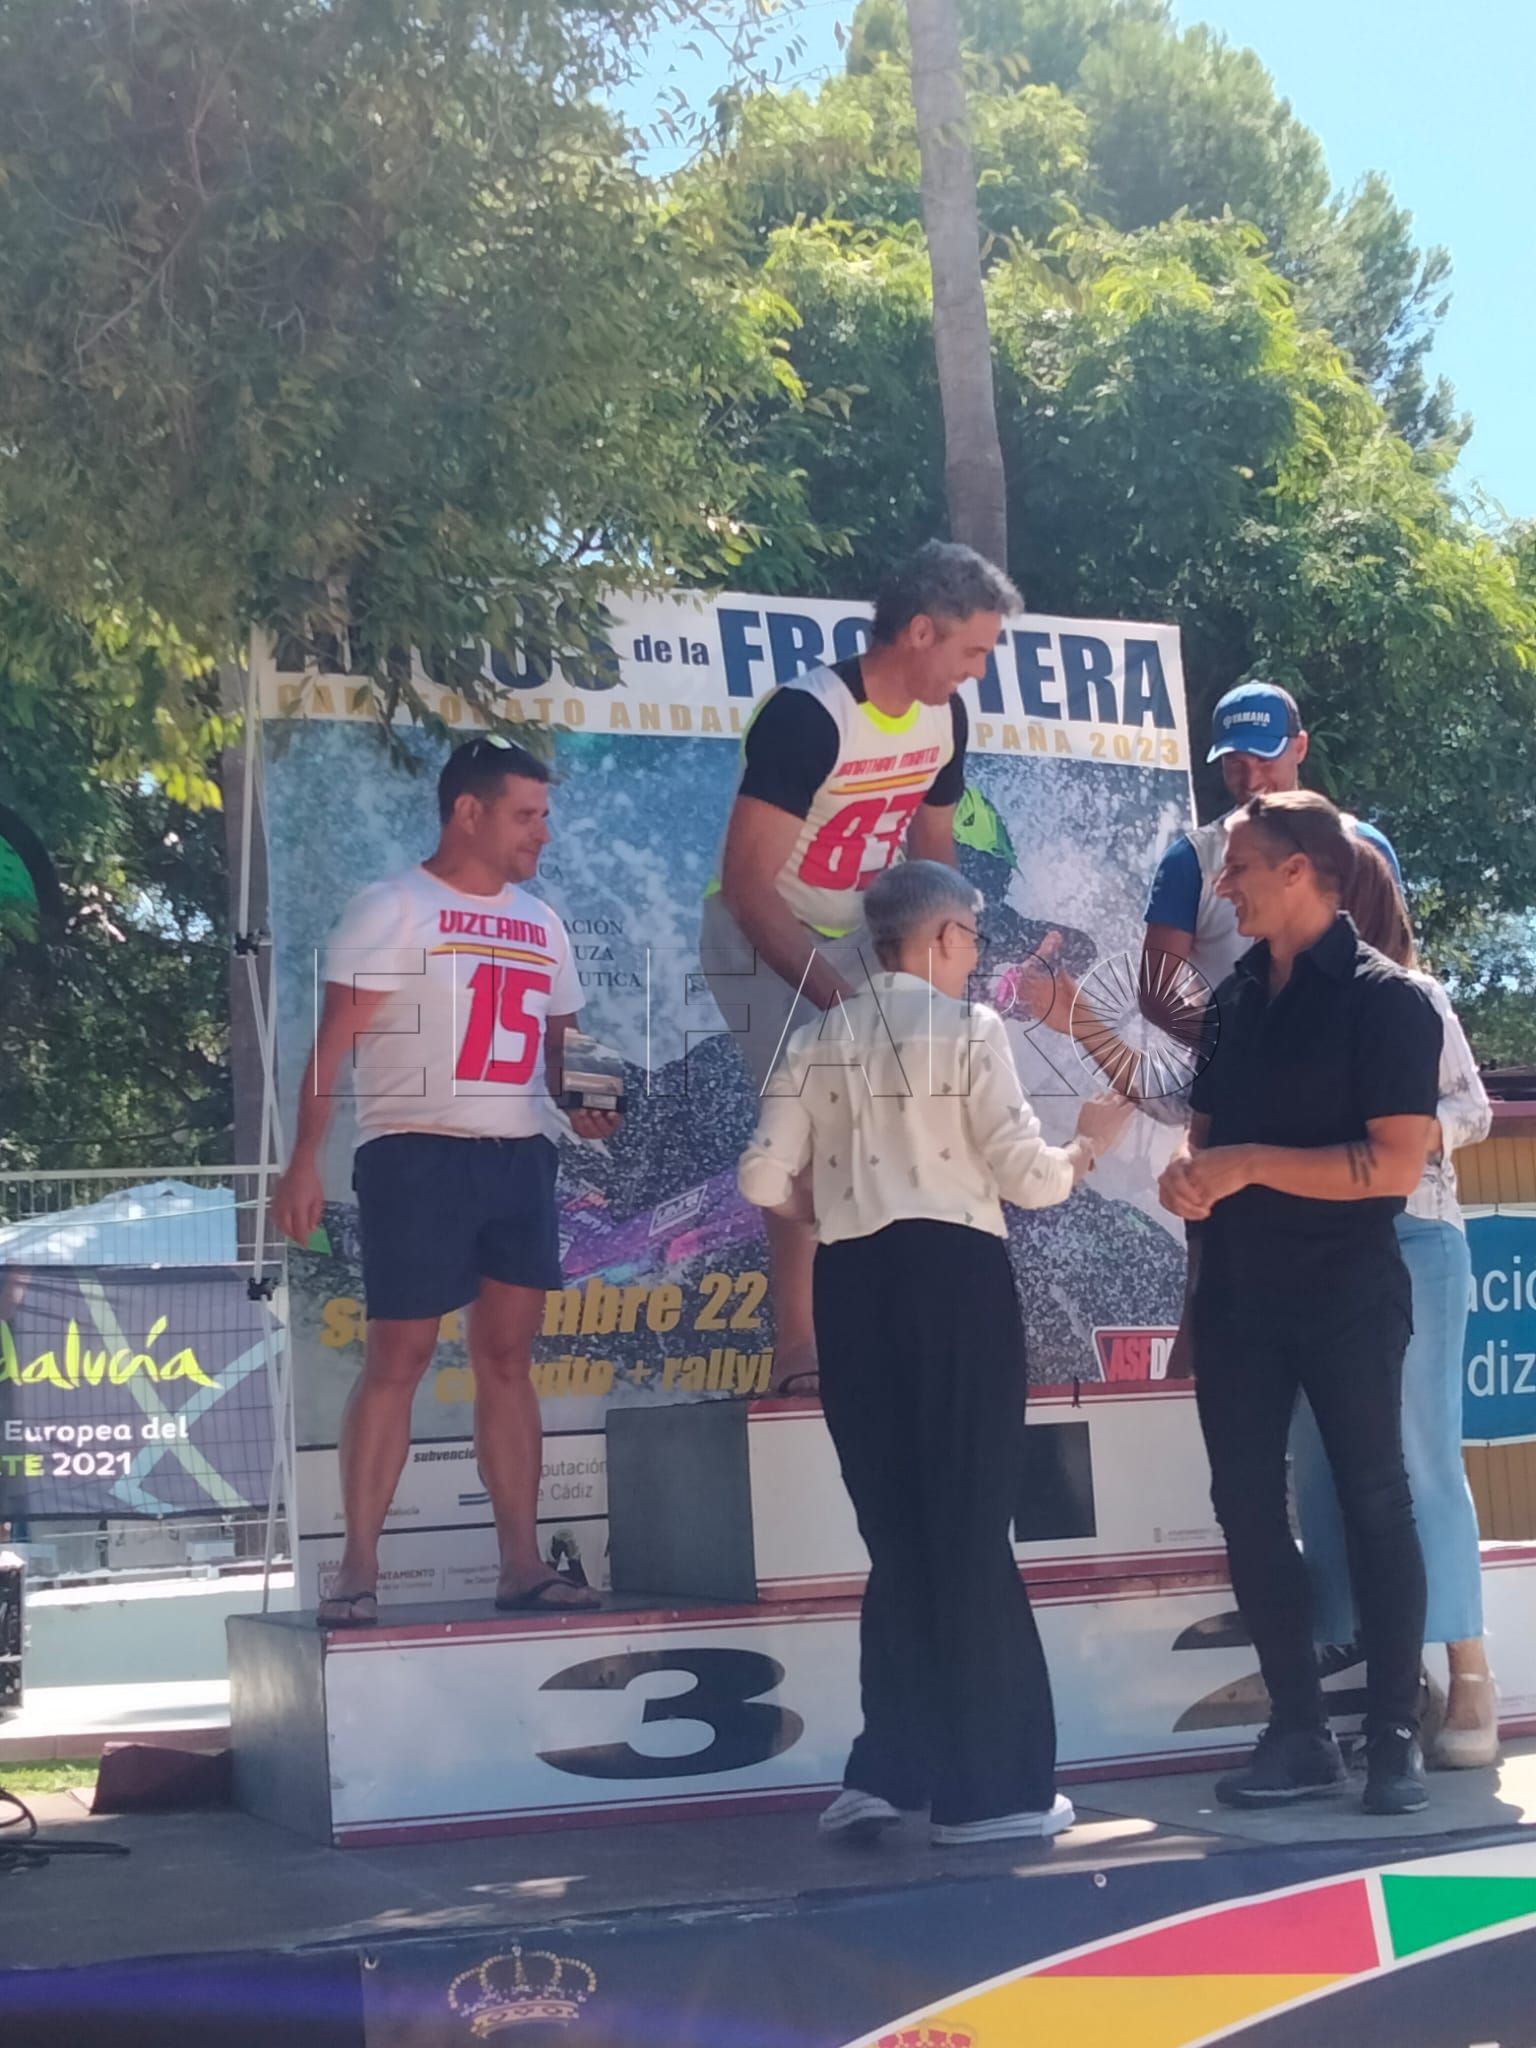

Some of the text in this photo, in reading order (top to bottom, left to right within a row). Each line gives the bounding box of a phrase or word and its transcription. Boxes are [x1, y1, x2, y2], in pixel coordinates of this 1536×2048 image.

[634, 635, 672, 663] de
[681, 637, 710, 666] la
[717, 608, 1176, 730] FROTERA
[609, 701, 745, 733] ANDAL
[975, 720, 1073, 754] PAÑA
[1089, 732, 1180, 765] 2023
[1232, 711, 1270, 724] YAMAHA
[574, 944, 615, 961] UZA
[578, 970, 642, 988] UTICA
[452, 963, 552, 1086] 15
[694, 1271, 768, 1331] 22
[0, 1316, 223, 1390] dalucía
[4, 1416, 189, 1448] Europea del
[0, 1451, 132, 1477] TE 2021
[551, 1482, 593, 1501] Cádiz
[536, 1647, 805, 1780] 3
